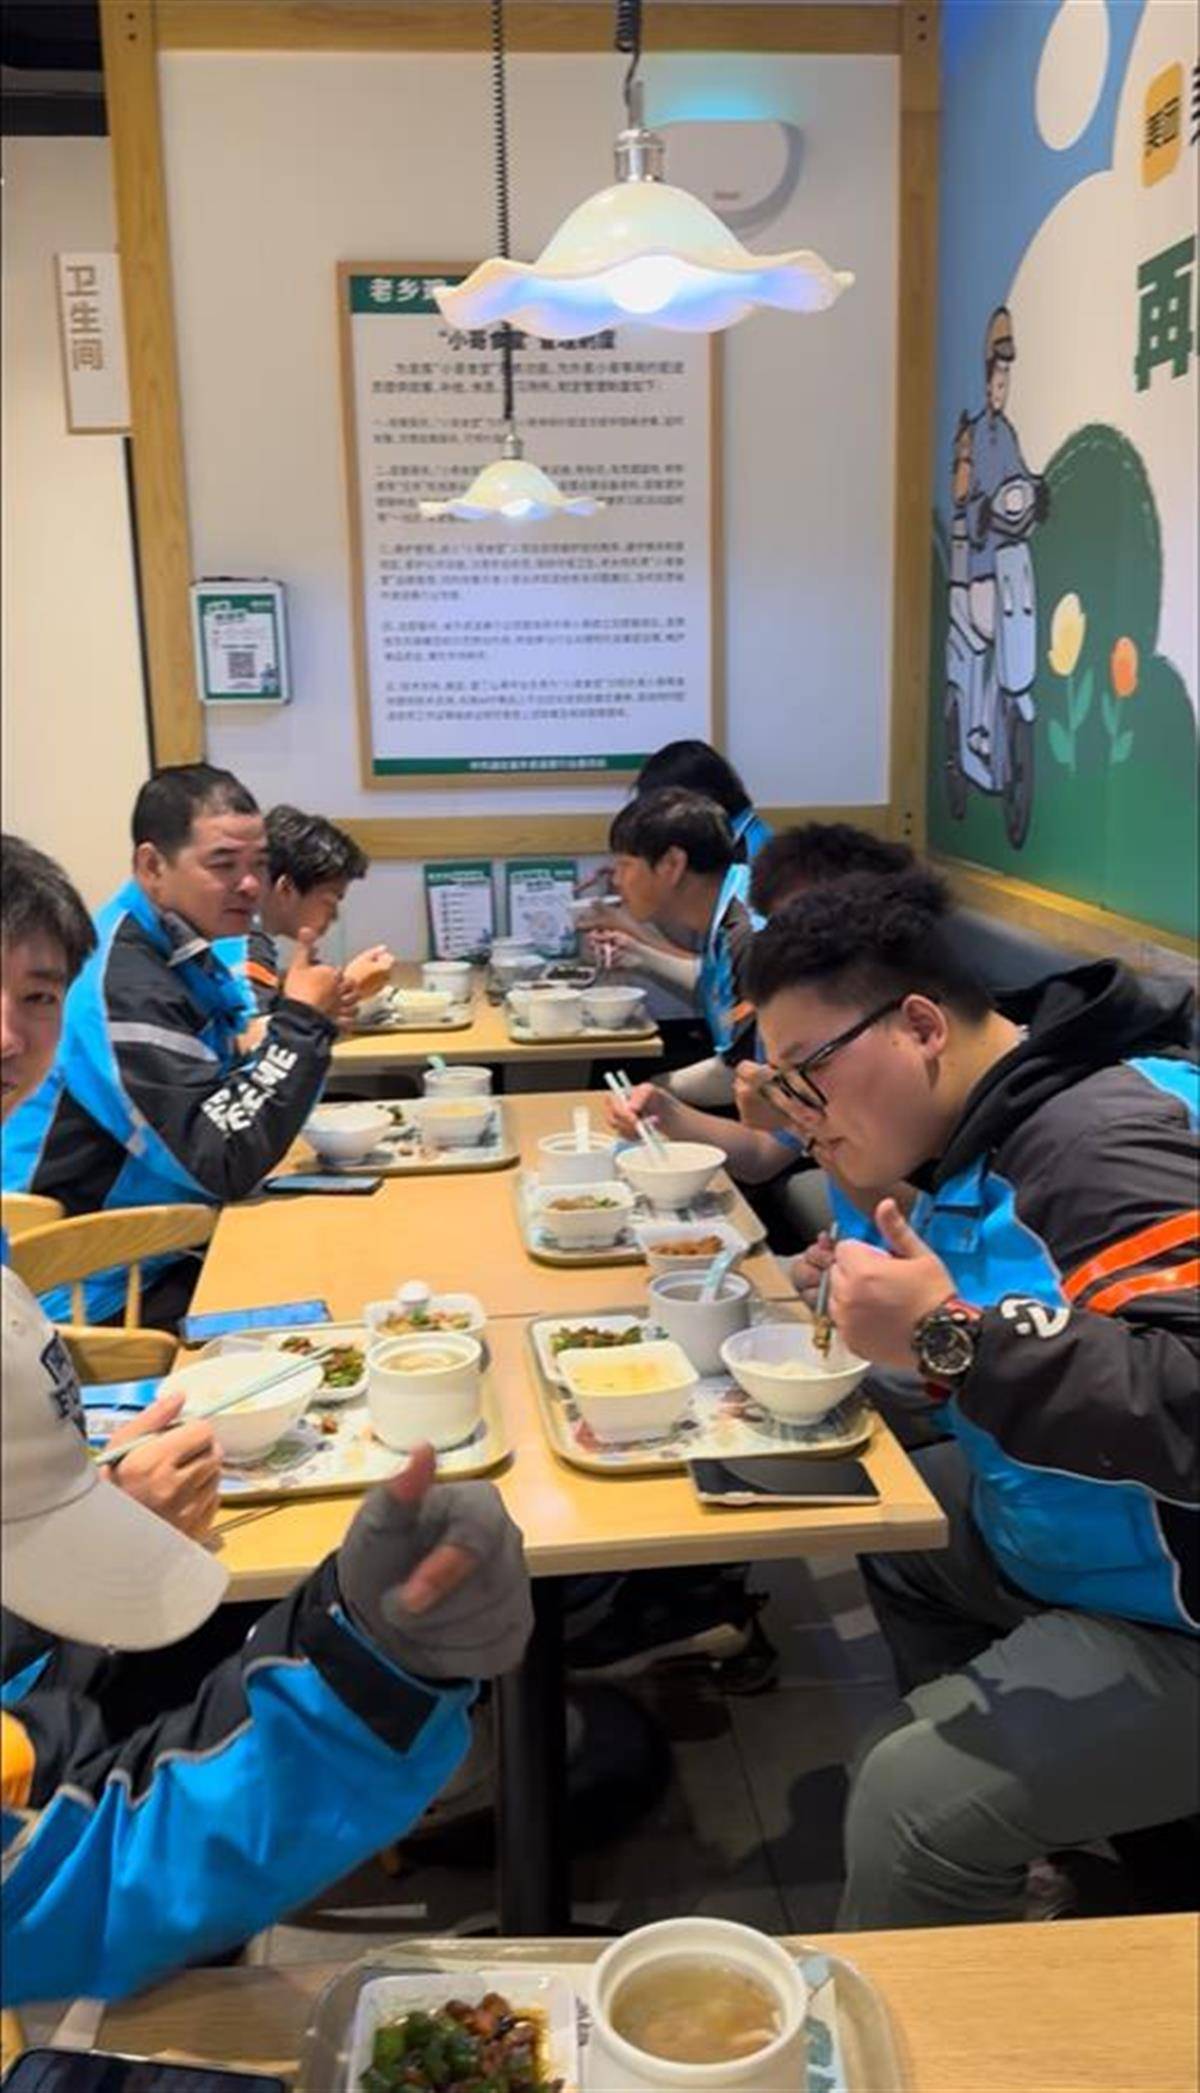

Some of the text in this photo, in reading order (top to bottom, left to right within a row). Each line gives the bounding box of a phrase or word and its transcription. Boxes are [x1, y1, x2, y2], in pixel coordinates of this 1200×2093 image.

[65, 264, 104, 371] 卫生间
[1134, 235, 1196, 393] 再
